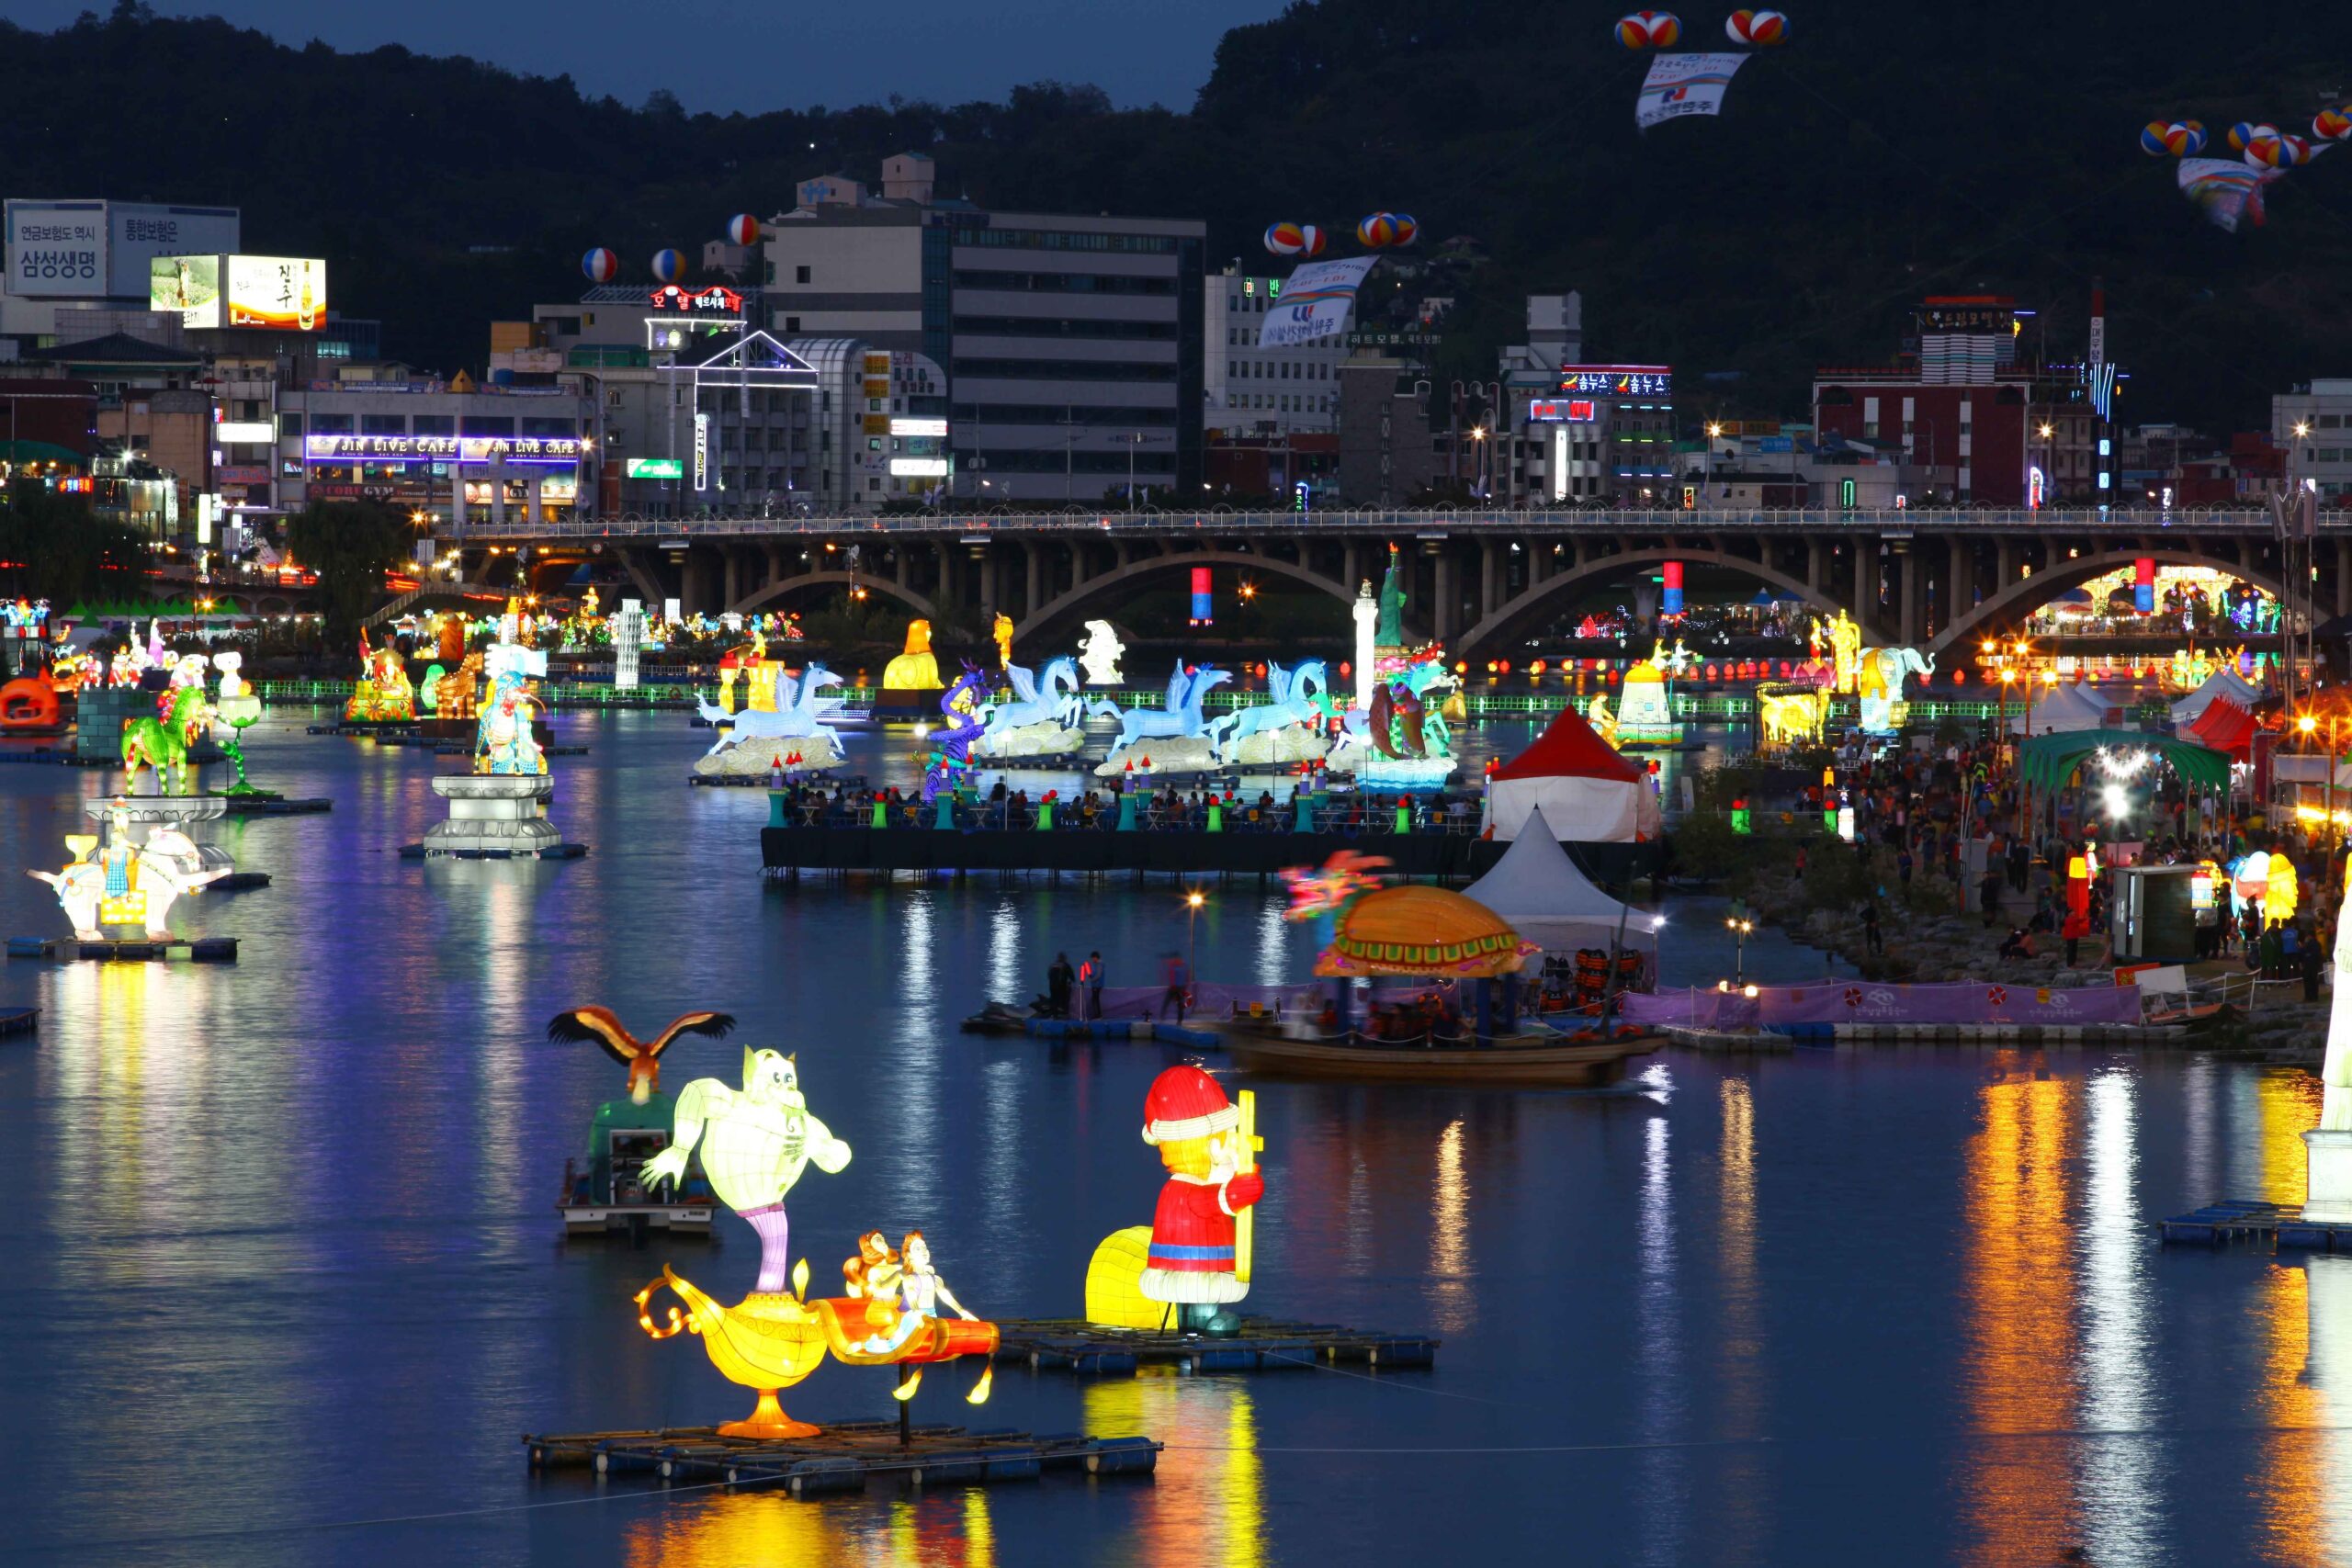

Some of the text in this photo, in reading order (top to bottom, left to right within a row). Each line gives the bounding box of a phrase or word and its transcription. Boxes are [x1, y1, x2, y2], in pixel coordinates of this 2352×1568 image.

[21, 225, 95, 243] 연금보험도 역시
[126, 219, 178, 243] 통합보험은
[20, 250, 96, 278] 삼성생명
[277, 264, 293, 309] 진주
[1579, 374, 1664, 392] 솜누스 솜누스
[341, 441, 457, 452] JIN LIVE CAFE
[493, 443, 574, 453] JIN LIVE CAFE
[364, 486, 394, 496] GYM
